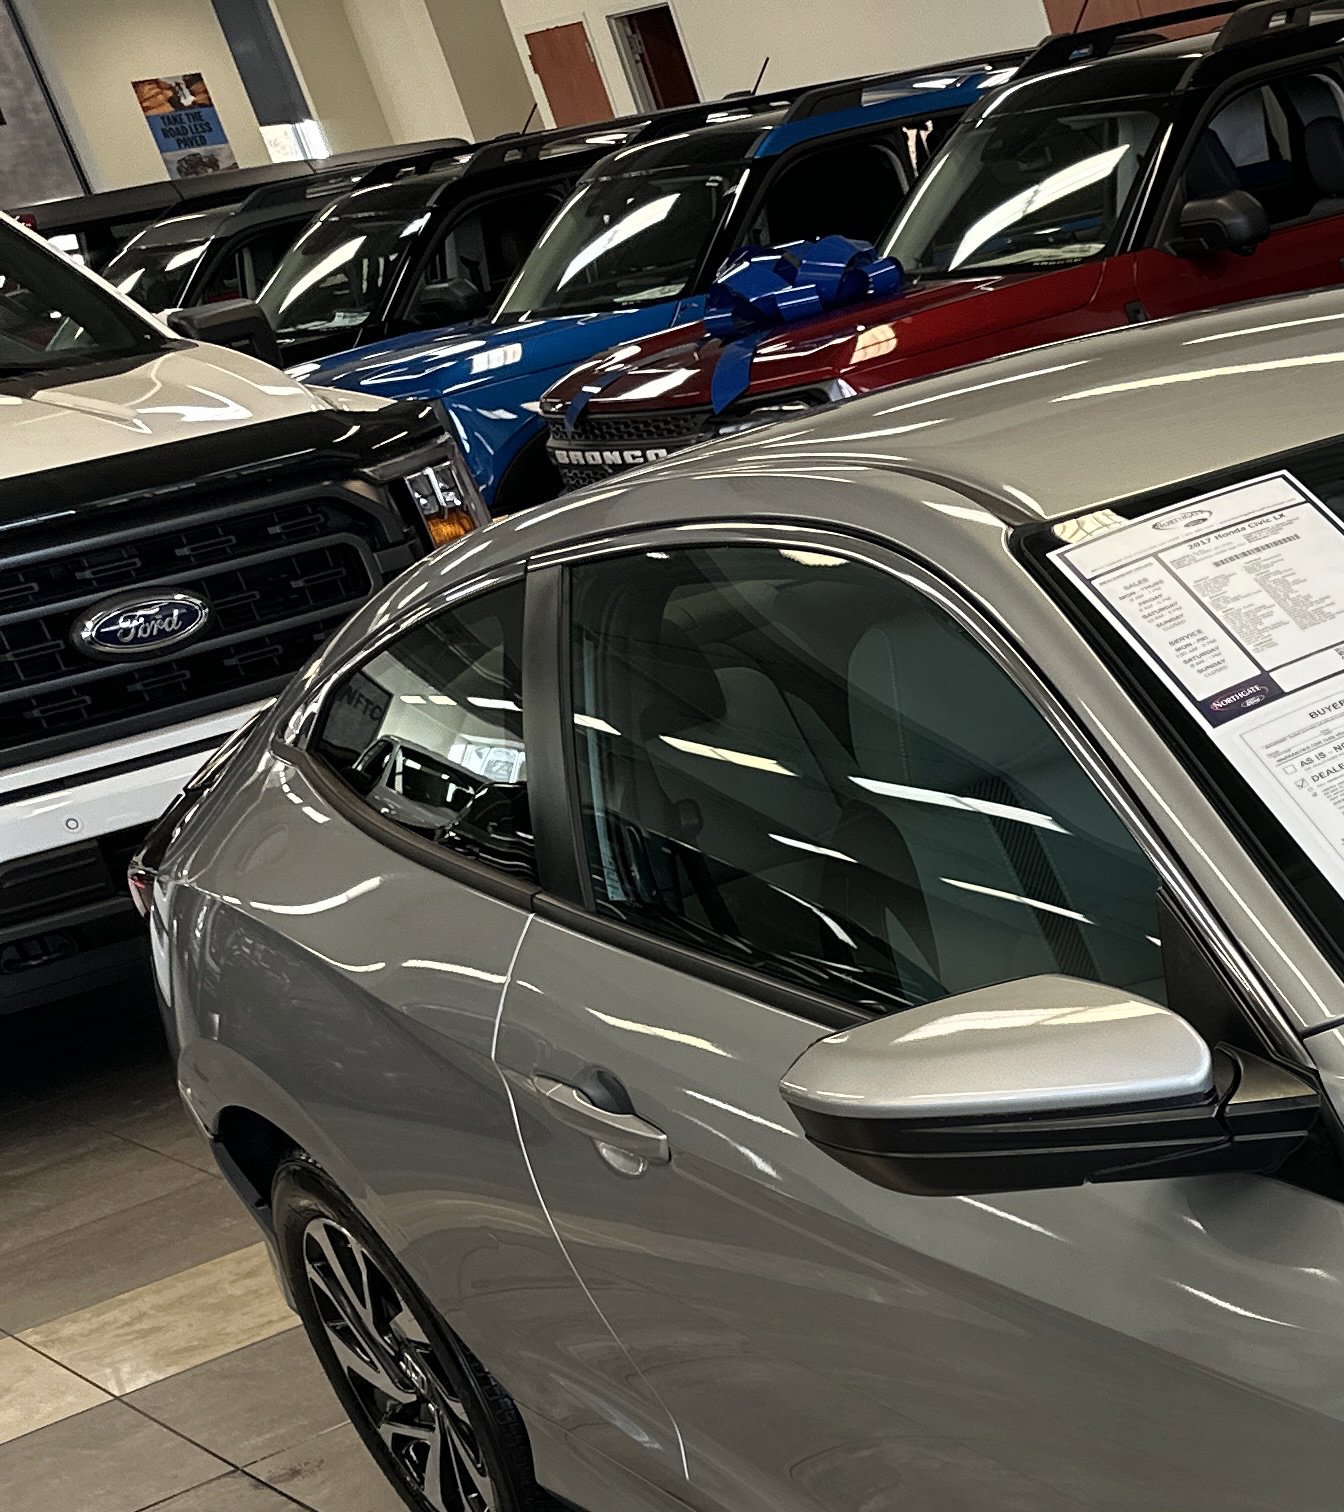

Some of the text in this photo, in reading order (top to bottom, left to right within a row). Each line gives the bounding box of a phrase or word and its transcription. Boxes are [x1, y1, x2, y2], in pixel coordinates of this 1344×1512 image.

[160, 111, 205, 127] TAKE THE
[161, 122, 213, 138] ROAD LESS
[176, 136, 207, 149] PAVED
[555, 449, 668, 465] BRONCO
[1187, 537, 1211, 550] 2017
[1214, 526, 1247, 541] Honda
[1248, 518, 1272, 530] Civic
[1274, 513, 1287, 522] LX
[1142, 601, 1178, 619] SATURDAY
[116, 606, 187, 643] Ford
[1183, 645, 1219, 664] SATURDAY
[1197, 659, 1225, 673] SUNDAY
[1213, 684, 1262, 709] NORTHGATE
[1299, 757, 1315, 767] AS
[1314, 751, 1327, 761] IS
